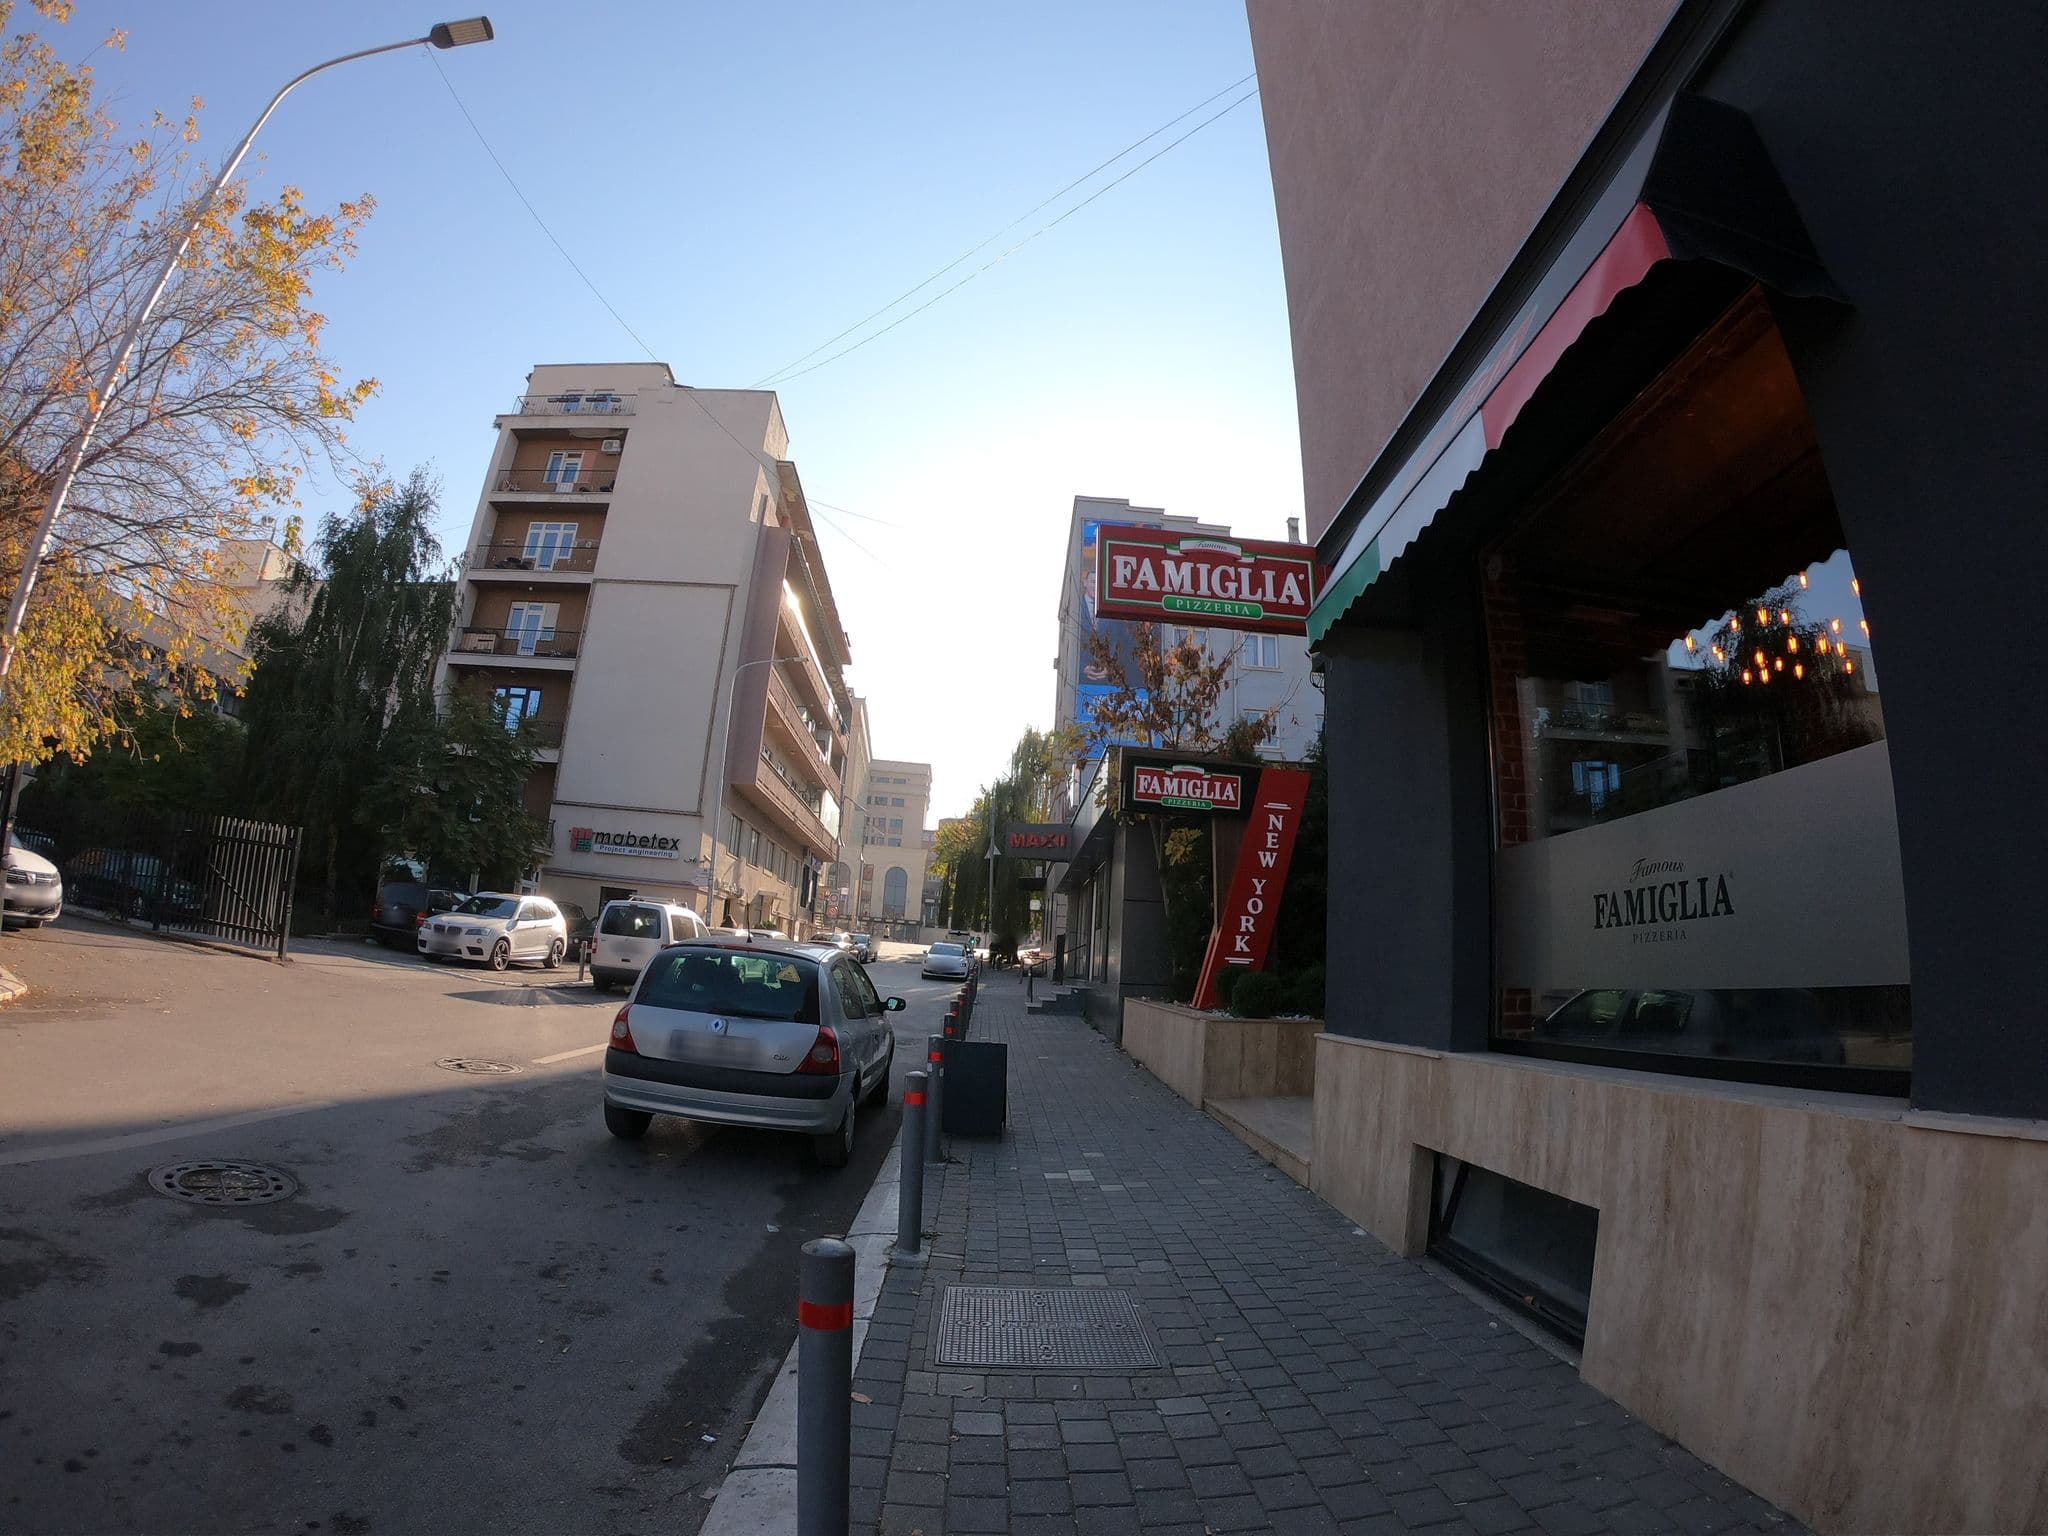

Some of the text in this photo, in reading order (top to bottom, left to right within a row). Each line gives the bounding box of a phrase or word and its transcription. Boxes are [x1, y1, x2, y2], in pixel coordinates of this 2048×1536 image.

[1112, 555, 1305, 606] FAMIGLIA
[1176, 599, 1250, 615] PIZZERIA
[1137, 774, 1237, 801] FAMIGLIA
[594, 831, 681, 851] mabetex
[600, 844, 674, 858] Project engineering
[1234, 813, 1284, 953] NEW YORK
[1629, 857, 1686, 883] Famous
[1593, 873, 1736, 930] FAMIGLIA
[1632, 929, 1688, 944] PIZZERIA
